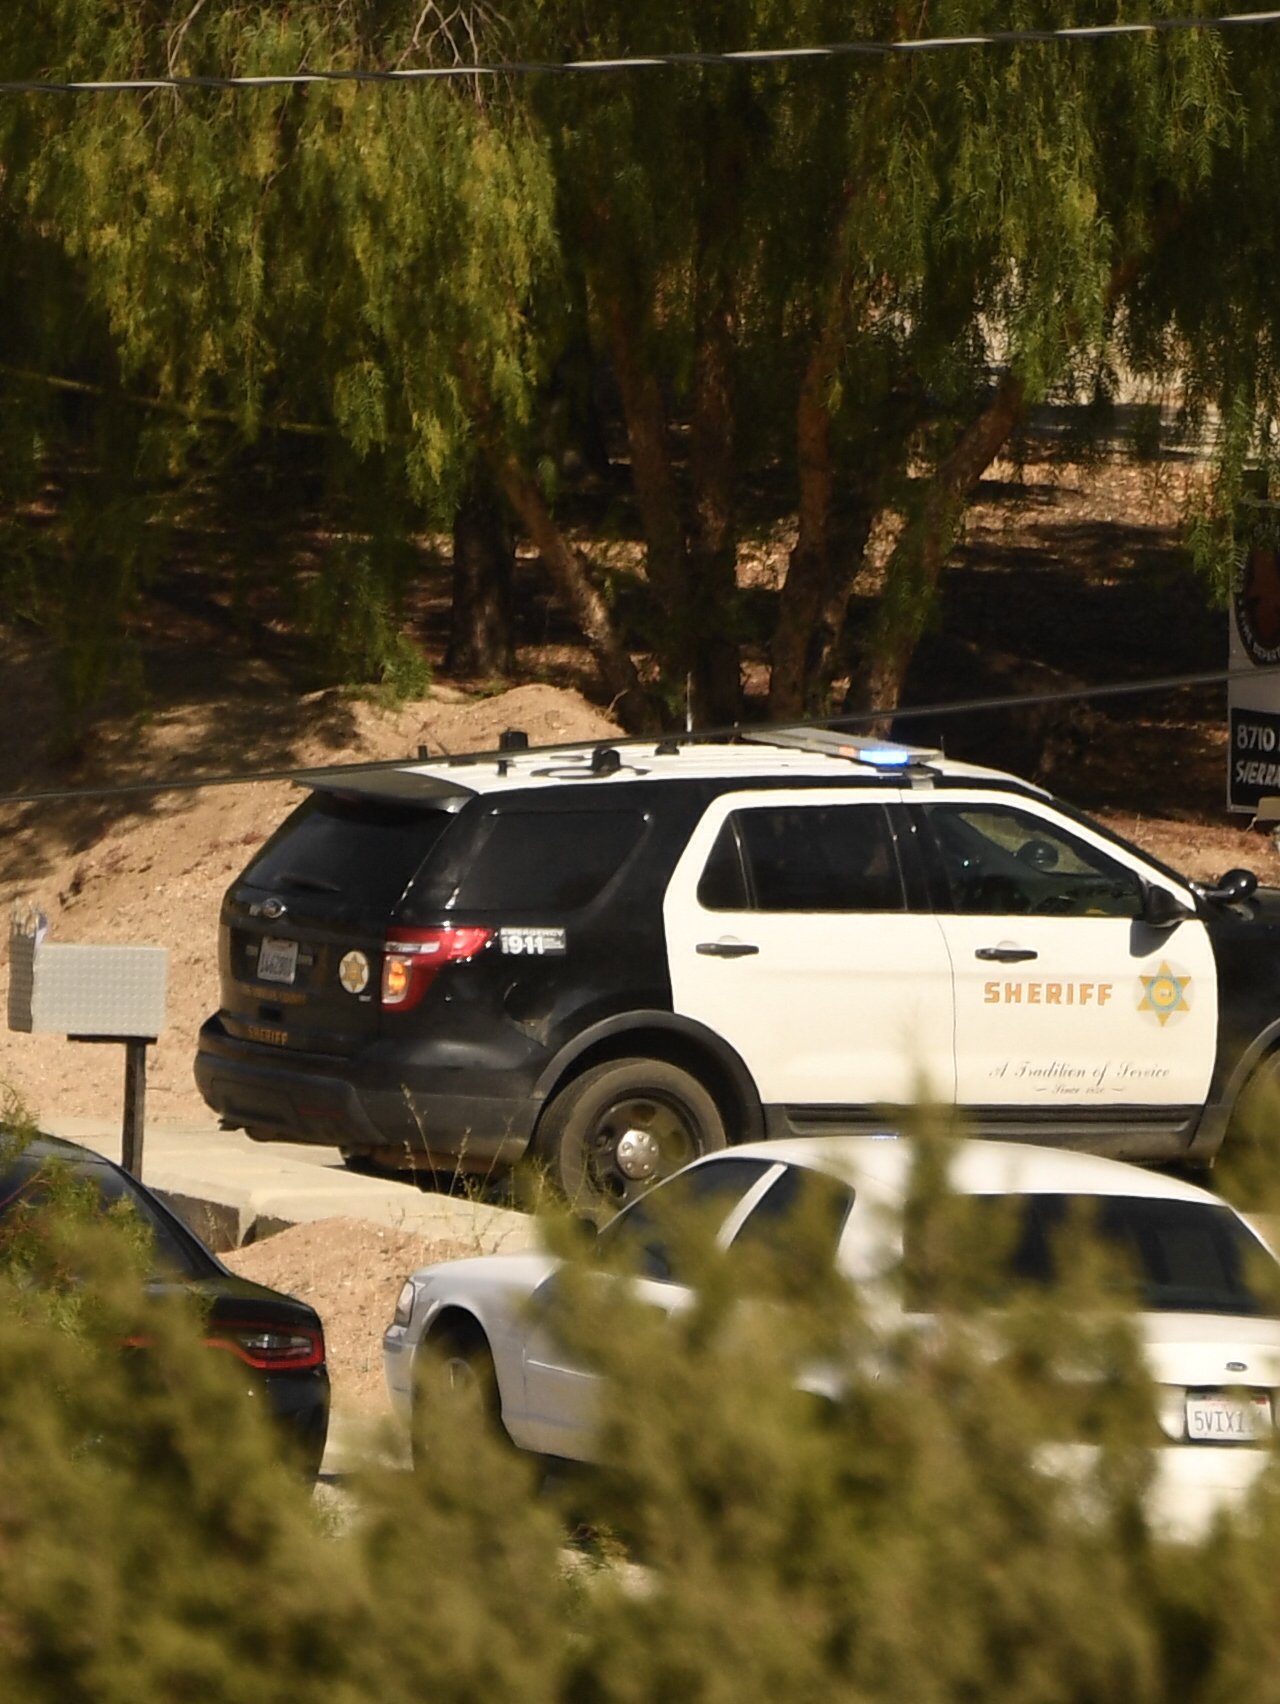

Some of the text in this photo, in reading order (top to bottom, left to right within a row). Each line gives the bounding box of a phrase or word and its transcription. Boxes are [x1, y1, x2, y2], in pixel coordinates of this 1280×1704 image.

[1236, 724, 1276, 752] 8710
[984, 981, 1113, 1006] SHERIFF
[1014, 1061, 1086, 1078] Tradition
[1092, 1060, 1110, 1087] of
[1116, 1062, 1170, 1078] Service
[1194, 1410, 1252, 1433] 5VIX1
